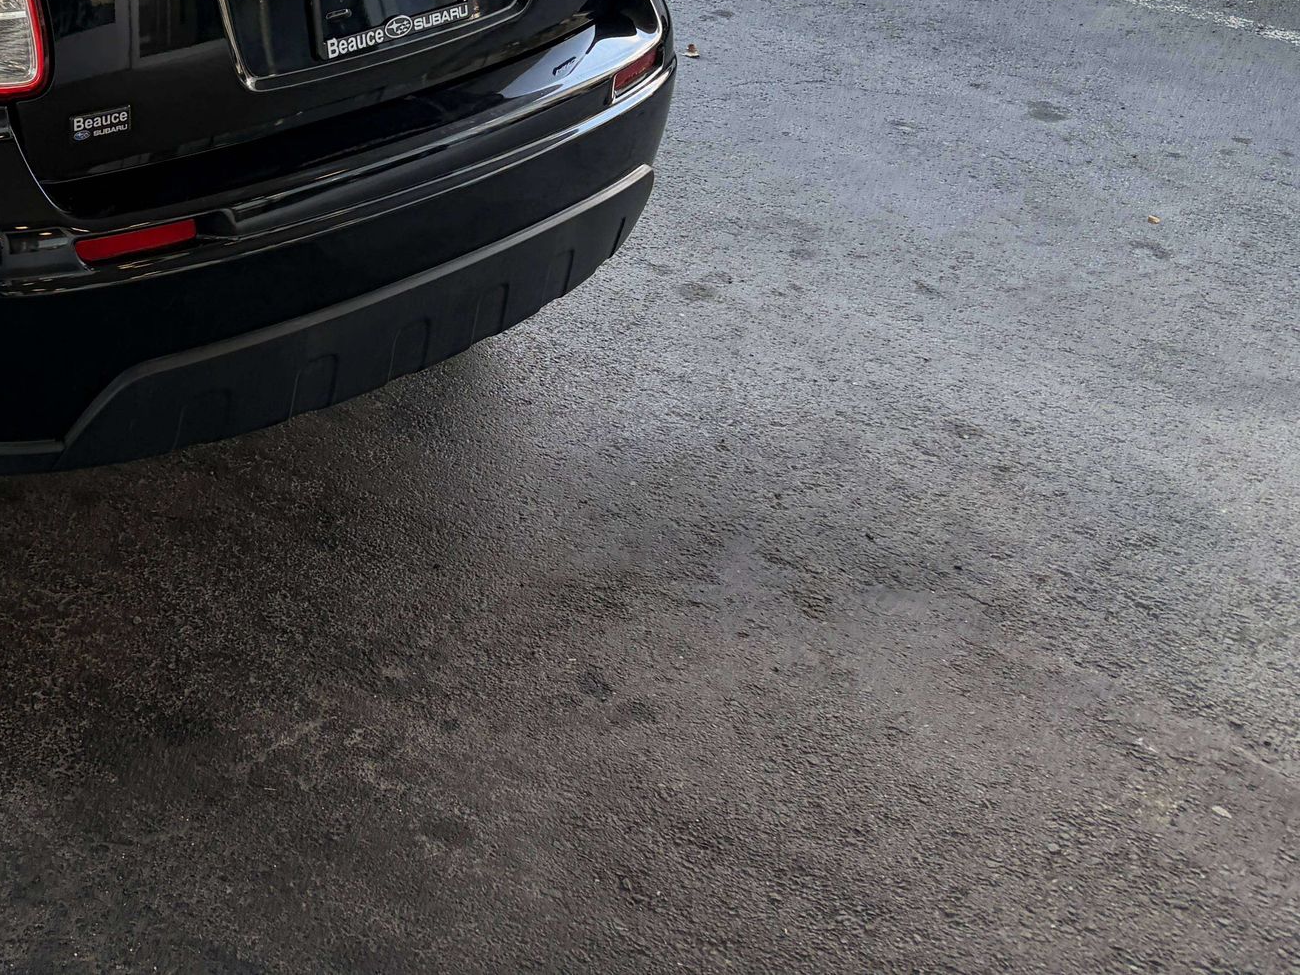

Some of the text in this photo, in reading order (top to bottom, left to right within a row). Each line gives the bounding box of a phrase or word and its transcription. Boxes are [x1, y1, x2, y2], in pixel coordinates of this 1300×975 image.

[326, 4, 469, 60] Beauce SUBARU
[73, 111, 129, 132] Beauce
[93, 123, 128, 137] SUBARU
